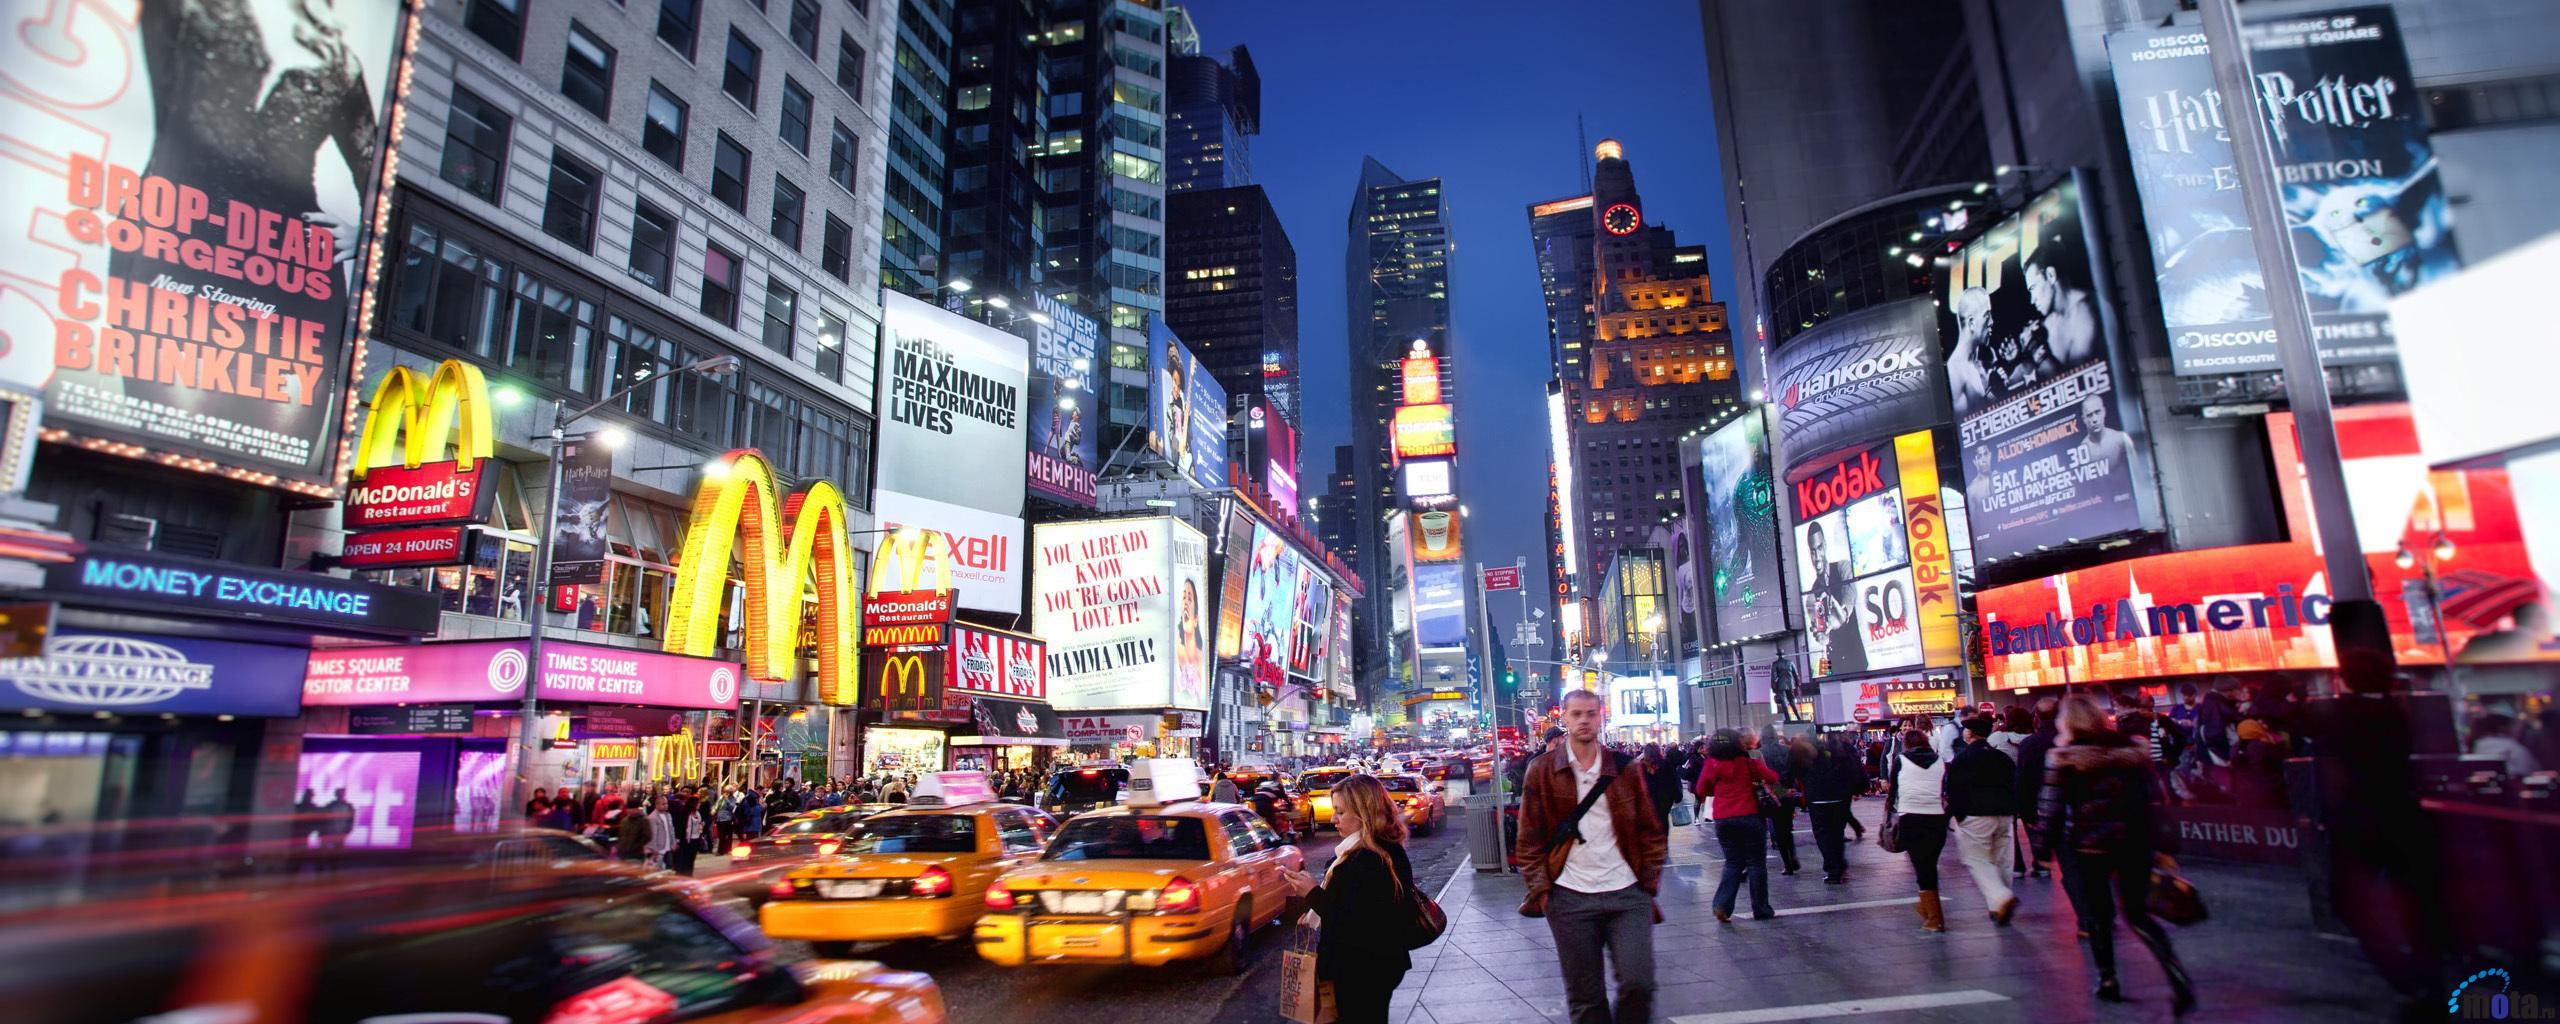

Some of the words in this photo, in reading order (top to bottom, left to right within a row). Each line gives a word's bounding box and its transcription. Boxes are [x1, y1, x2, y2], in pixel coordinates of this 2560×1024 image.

[2309, 27, 2381, 45] SQUARE
[2331, 16, 2357, 29] OF
[2176, 174, 2207, 187] THE
[66, 151, 335, 272] DROP-DEAD
[65, 207, 333, 301] GORGEOUS
[150, 273, 194, 297] Now
[199, 283, 277, 319] Starring
[58, 268, 325, 365] CHRISTIE
[1034, 290, 1097, 340] WINNER!
[55, 319, 324, 406] BRINKLEY
[894, 328, 954, 366] WHERE
[1036, 324, 1094, 375] BEST
[2193, 357, 2236, 367] BLOCKS
[2238, 354, 2276, 365] SOUTH
[893, 348, 1017, 412] MAXIMUM
[1814, 384, 1855, 404] driving
[1859, 369, 1925, 389] emotion
[890, 395, 953, 435] LIVES
[891, 375, 1016, 430] PERFORMANCE
[1961, 399, 2030, 445] ST-PIERRE
[2039, 366, 2111, 411] SHIELDS
[1399, 443, 1456, 456] TOSHIBA
[1997, 444, 2023, 463] ALDO
[1028, 451, 1097, 497] MEMPHIS
[1797, 450, 1885, 520] Kodak
[1992, 469, 2020, 494] SAT.
[2023, 454, 2066, 485] APRIL
[2067, 443, 2091, 469] 30
[347, 478, 471, 506] McDonald's
[1982, 493, 2008, 513] LIVE
[2007, 486, 2024, 505] ON
[2024, 458, 2110, 500] PAY-PER-VIEW
[365, 501, 447, 519] Restaurant
[344, 542, 381, 557] OPEN
[384, 541, 402, 554] 24
[405, 537, 454, 552] HOURS
[1043, 543, 1074, 567] YOU
[1081, 530, 1149, 561] ALREADY
[1906, 493, 1950, 606] Kodak
[83, 559, 211, 597] MONEY
[217, 576, 371, 616] EXCHANGE
[1075, 557, 1124, 585] KNOW
[1495, 569, 1516, 577] STOPPING
[866, 599, 948, 615] McDonald's
[1045, 583, 1102, 613] YOU'RE
[1107, 575, 1162, 604] GONNA
[1865, 580, 1907, 630] SO
[879, 612, 933, 623] Restaurant
[1072, 605, 1114, 633] LOVE
[1119, 600, 1140, 625] IT!
[1988, 611, 2070, 657] Bank
[2072, 600, 2109, 647] of
[86, 660, 214, 684] EXCHANGE
[347, 657, 404, 675] SQUARE
[547, 653, 588, 673] TIMES
[591, 655, 639, 678] SQUARE
[966, 658, 991, 673] FRIDAYS
[1012, 665, 1033, 679] FRIDAYS
[1047, 645, 1114, 679] MAMMA
[1117, 637, 1156, 670] MIA!
[355, 674, 410, 693] CENTER
[544, 671, 594, 693] VISITOR
[598, 674, 643, 696] CENTER
[1885, 681, 1956, 690] MARQUIS
[1889, 701, 1955, 714] WONDERLAND
[2178, 820, 2258, 845] FATHER
[2264, 826, 2299, 849] DU
[1282, 977, 1302, 992] EAGLE
